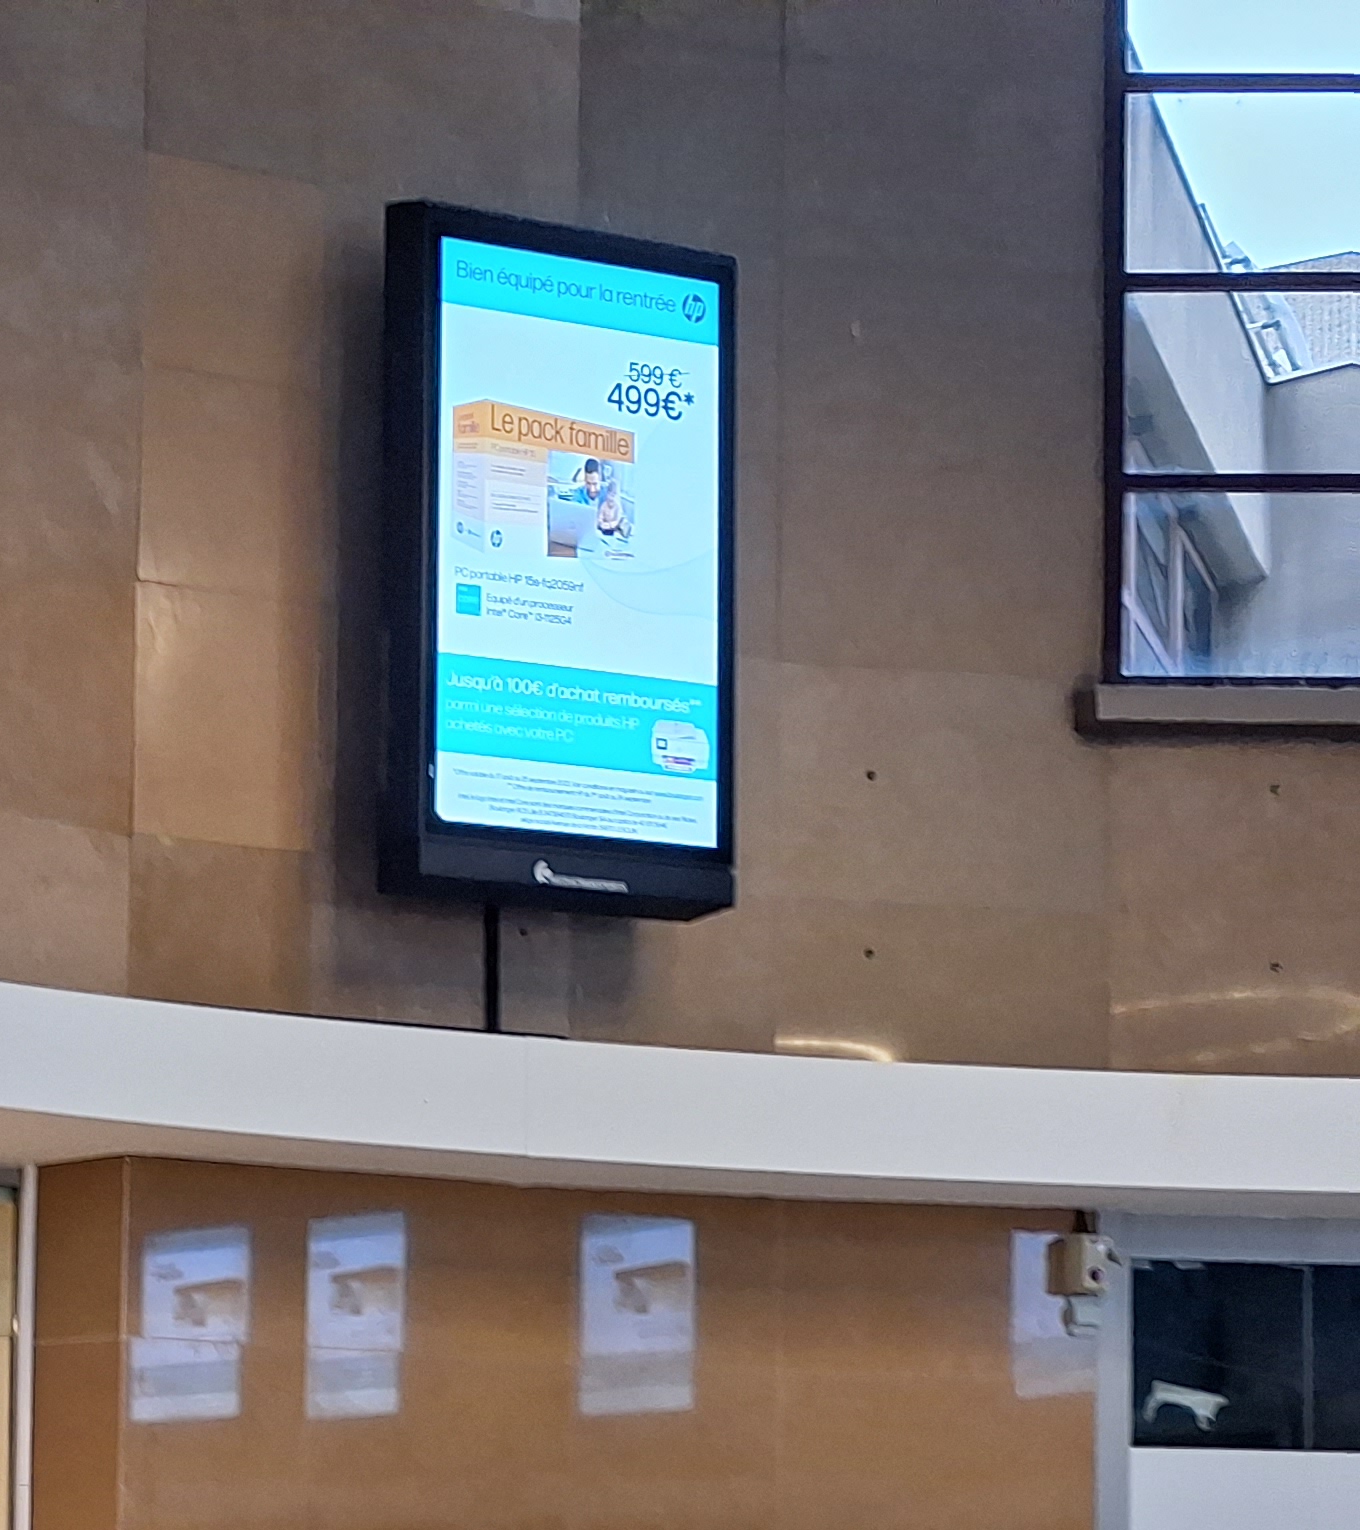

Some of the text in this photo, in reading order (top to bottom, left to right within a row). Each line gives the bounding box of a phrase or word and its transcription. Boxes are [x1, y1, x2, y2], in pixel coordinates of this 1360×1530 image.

[456, 260, 706, 324] Bien équipé pour la rentrée hp
[628, 362, 664, 385] 599
[490, 403, 514, 434] Le
[518, 412, 566, 444] pack
[568, 421, 631, 456] famille
[507, 677, 544, 696] 100€
[546, 682, 600, 703] d'achat
